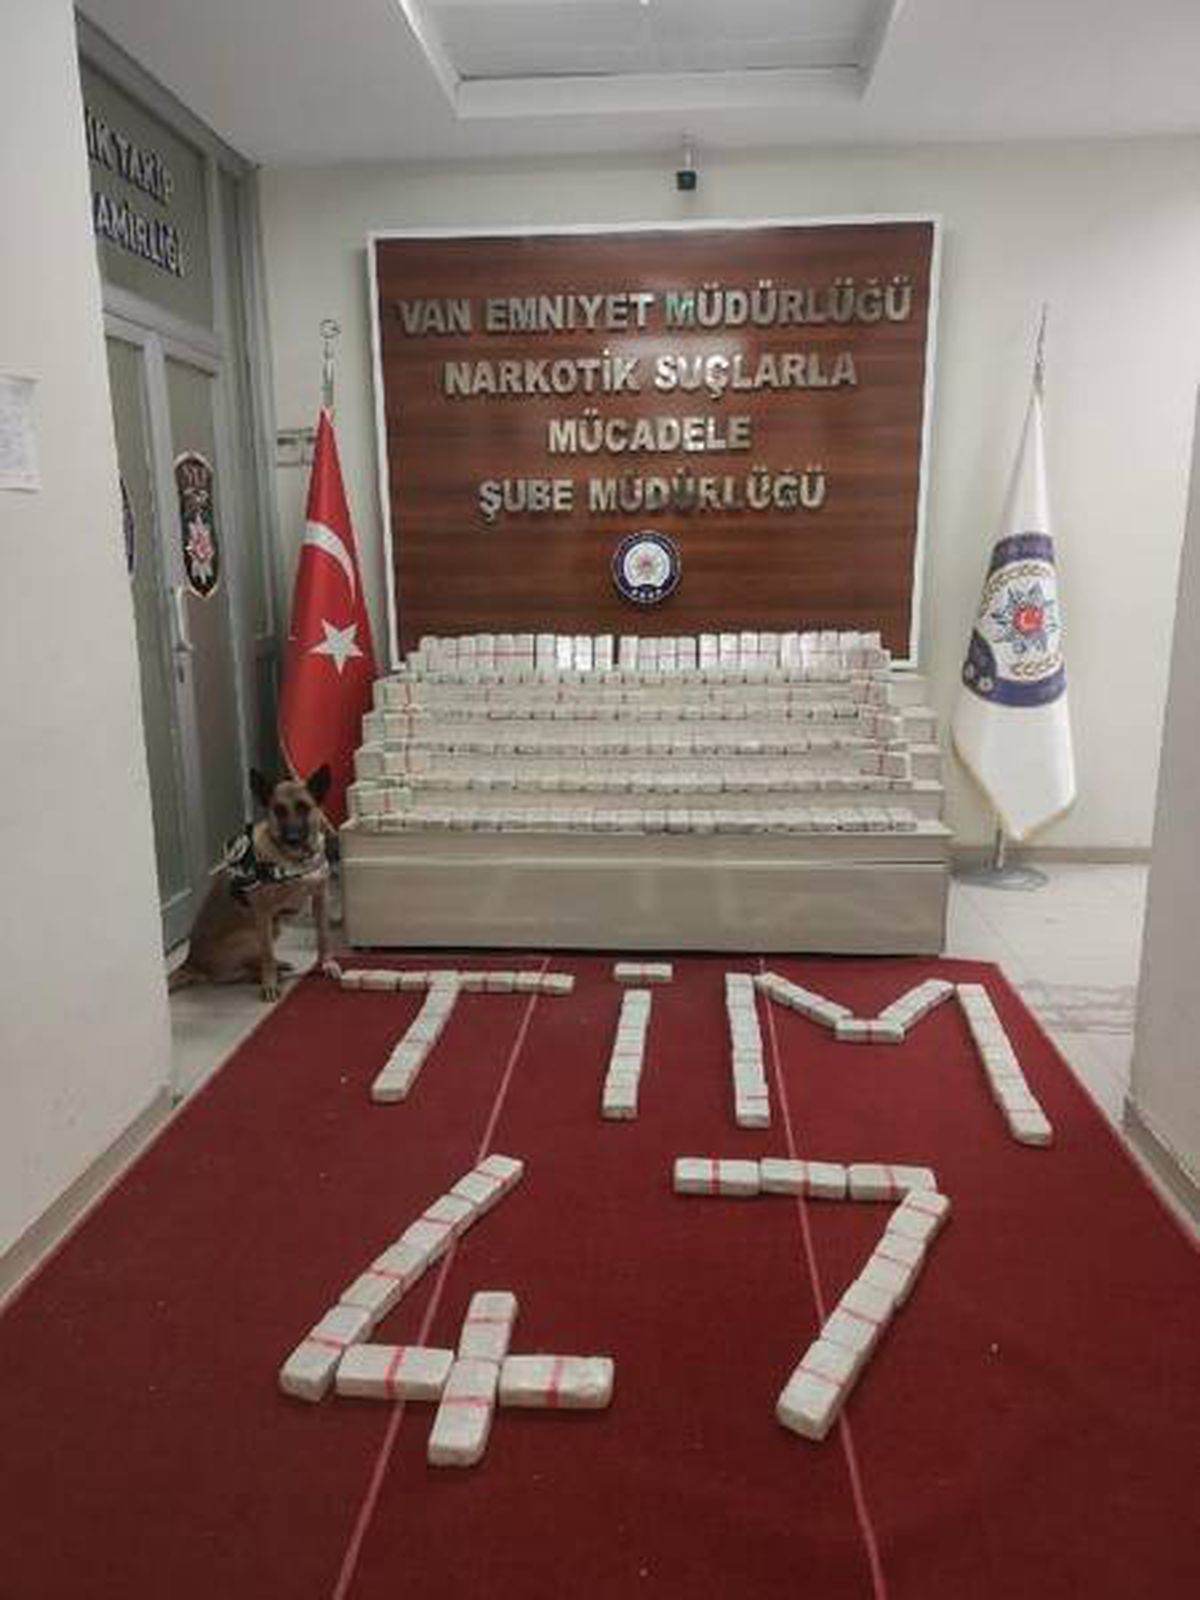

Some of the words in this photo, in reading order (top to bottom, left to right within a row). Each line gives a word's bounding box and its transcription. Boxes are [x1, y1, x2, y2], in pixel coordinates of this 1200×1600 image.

[402, 298, 471, 334] VAN
[664, 276, 911, 328] MÜDÜRLÜĞÜ
[444, 349, 642, 396] NARKOTİK
[654, 352, 858, 398] SUÇLARLA
[547, 408, 752, 455] MÜCADELE
[478, 478, 574, 524] ŞUBE
